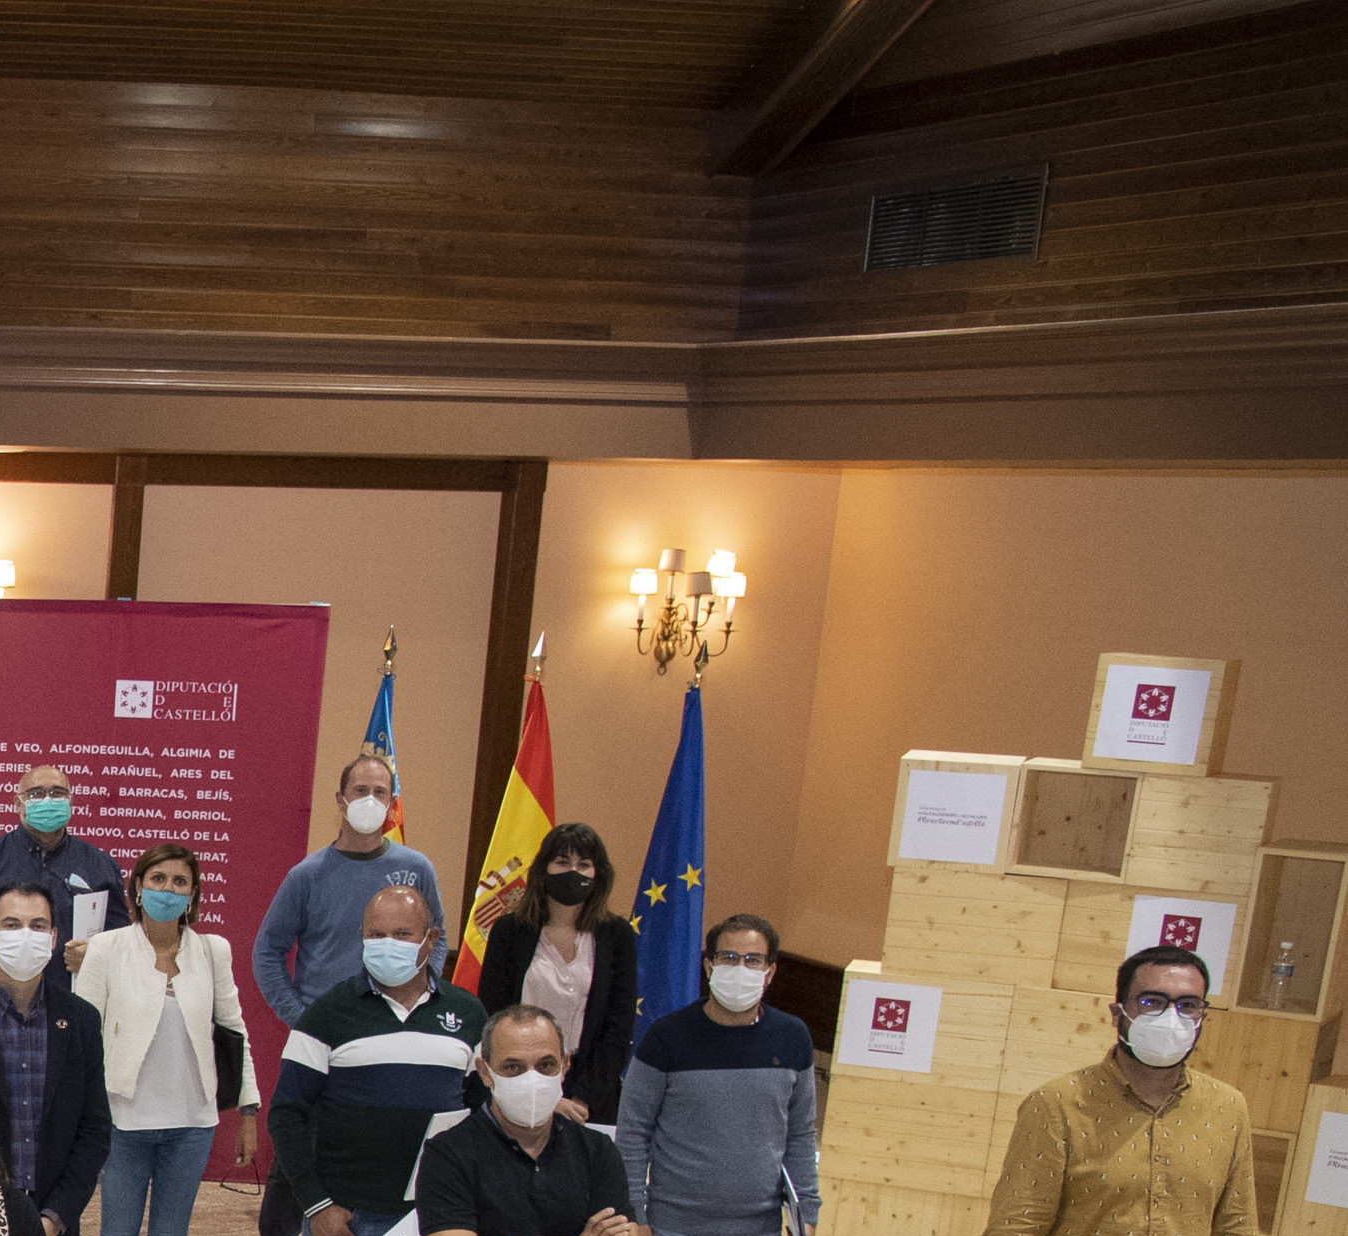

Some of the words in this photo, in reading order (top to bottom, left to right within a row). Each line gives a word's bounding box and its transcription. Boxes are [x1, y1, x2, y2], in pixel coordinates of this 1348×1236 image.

[155, 680, 233, 694] DIPUTACIÓ
[155, 694, 165, 706] D
[223, 696, 232, 708] E
[153, 707, 231, 722] CASTELLÓ
[14, 742, 43, 755] VEO,
[49, 743, 154, 758] ALFONDEGUILLA,
[160, 747, 212, 759] ALGIMIA
[218, 749, 235, 759] DE
[170, 768, 203, 779] ARES
[210, 769, 234, 780] DEL
[118, 786, 188, 801] BARRACAS,
[99, 806, 167, 820] BORRIANA,
[173, 809, 231, 823] BORRIOL,
